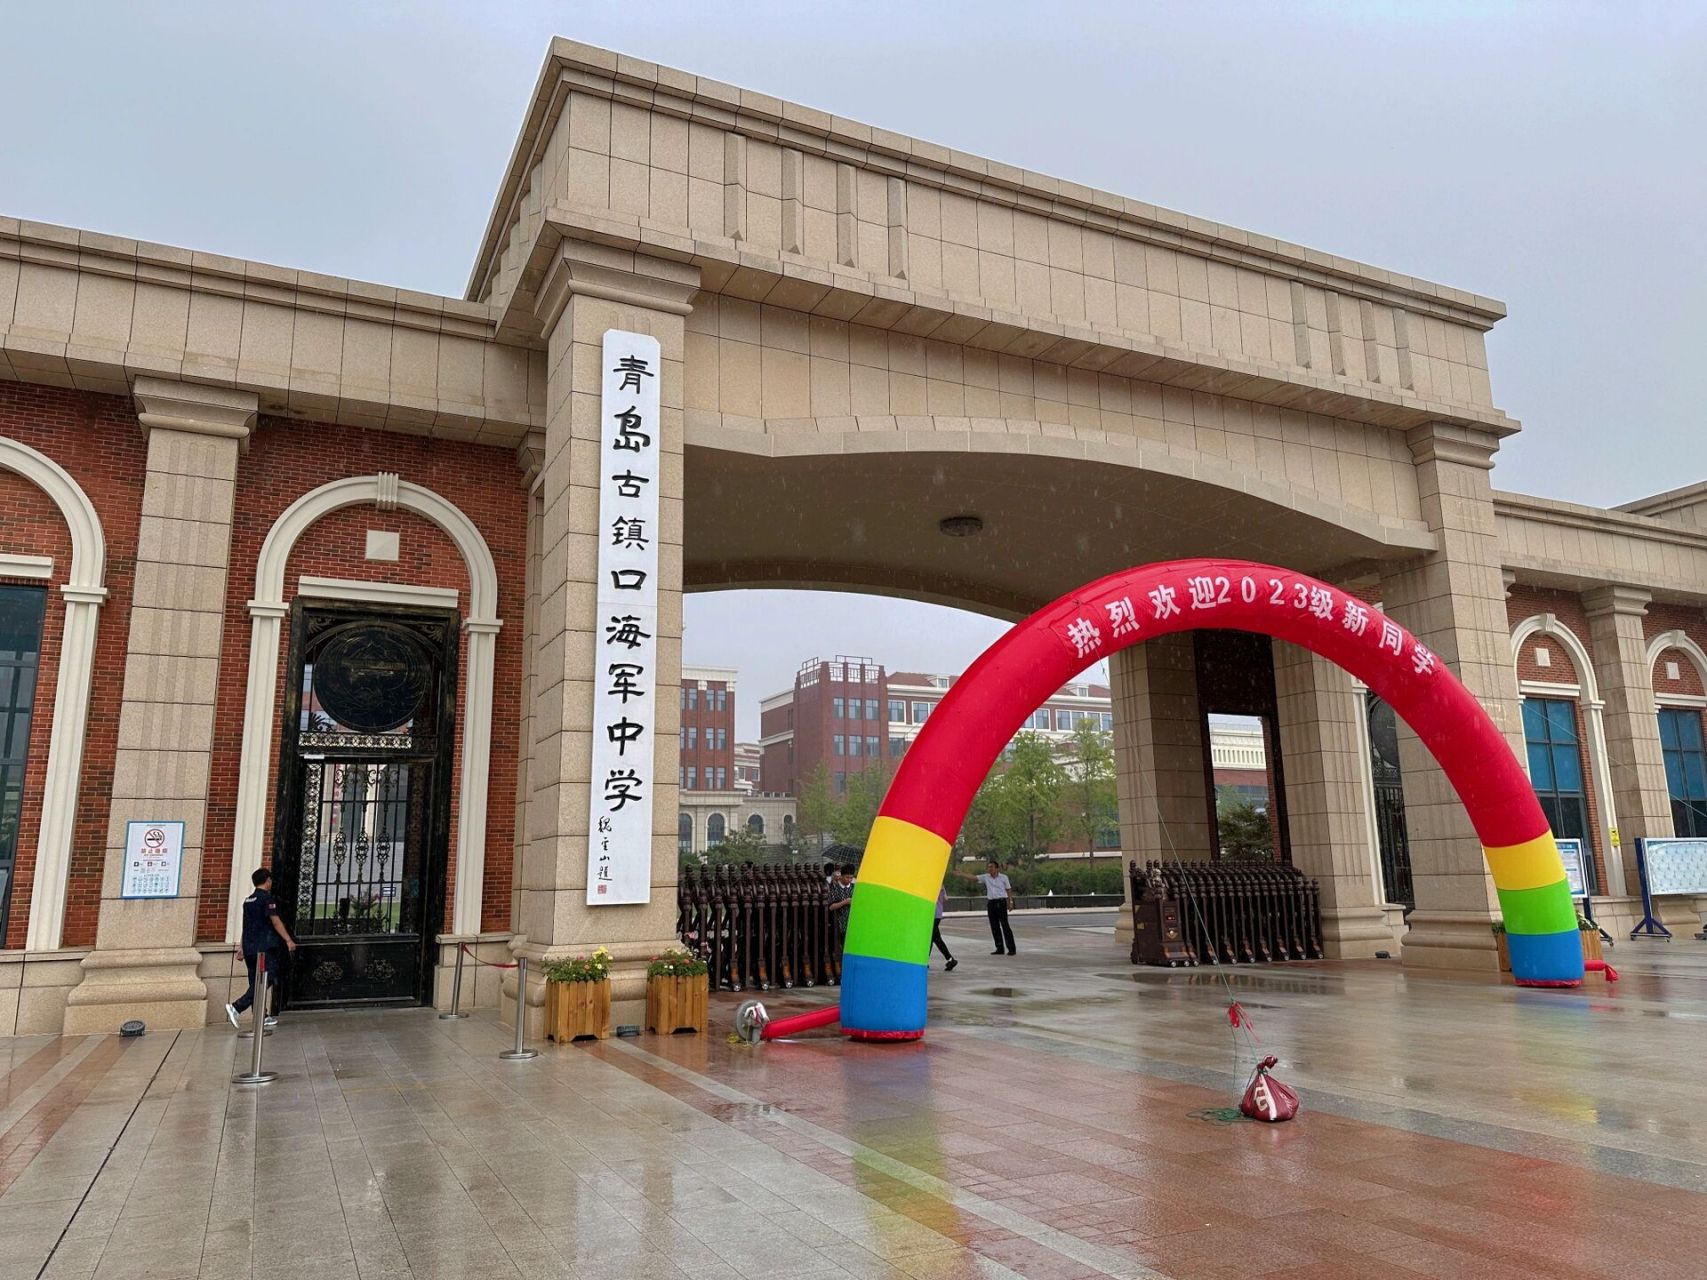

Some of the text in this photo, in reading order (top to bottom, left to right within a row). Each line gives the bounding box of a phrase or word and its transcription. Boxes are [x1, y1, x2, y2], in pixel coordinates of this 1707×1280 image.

[1067, 576, 1435, 676] 热烈欢迎2023级新同学
